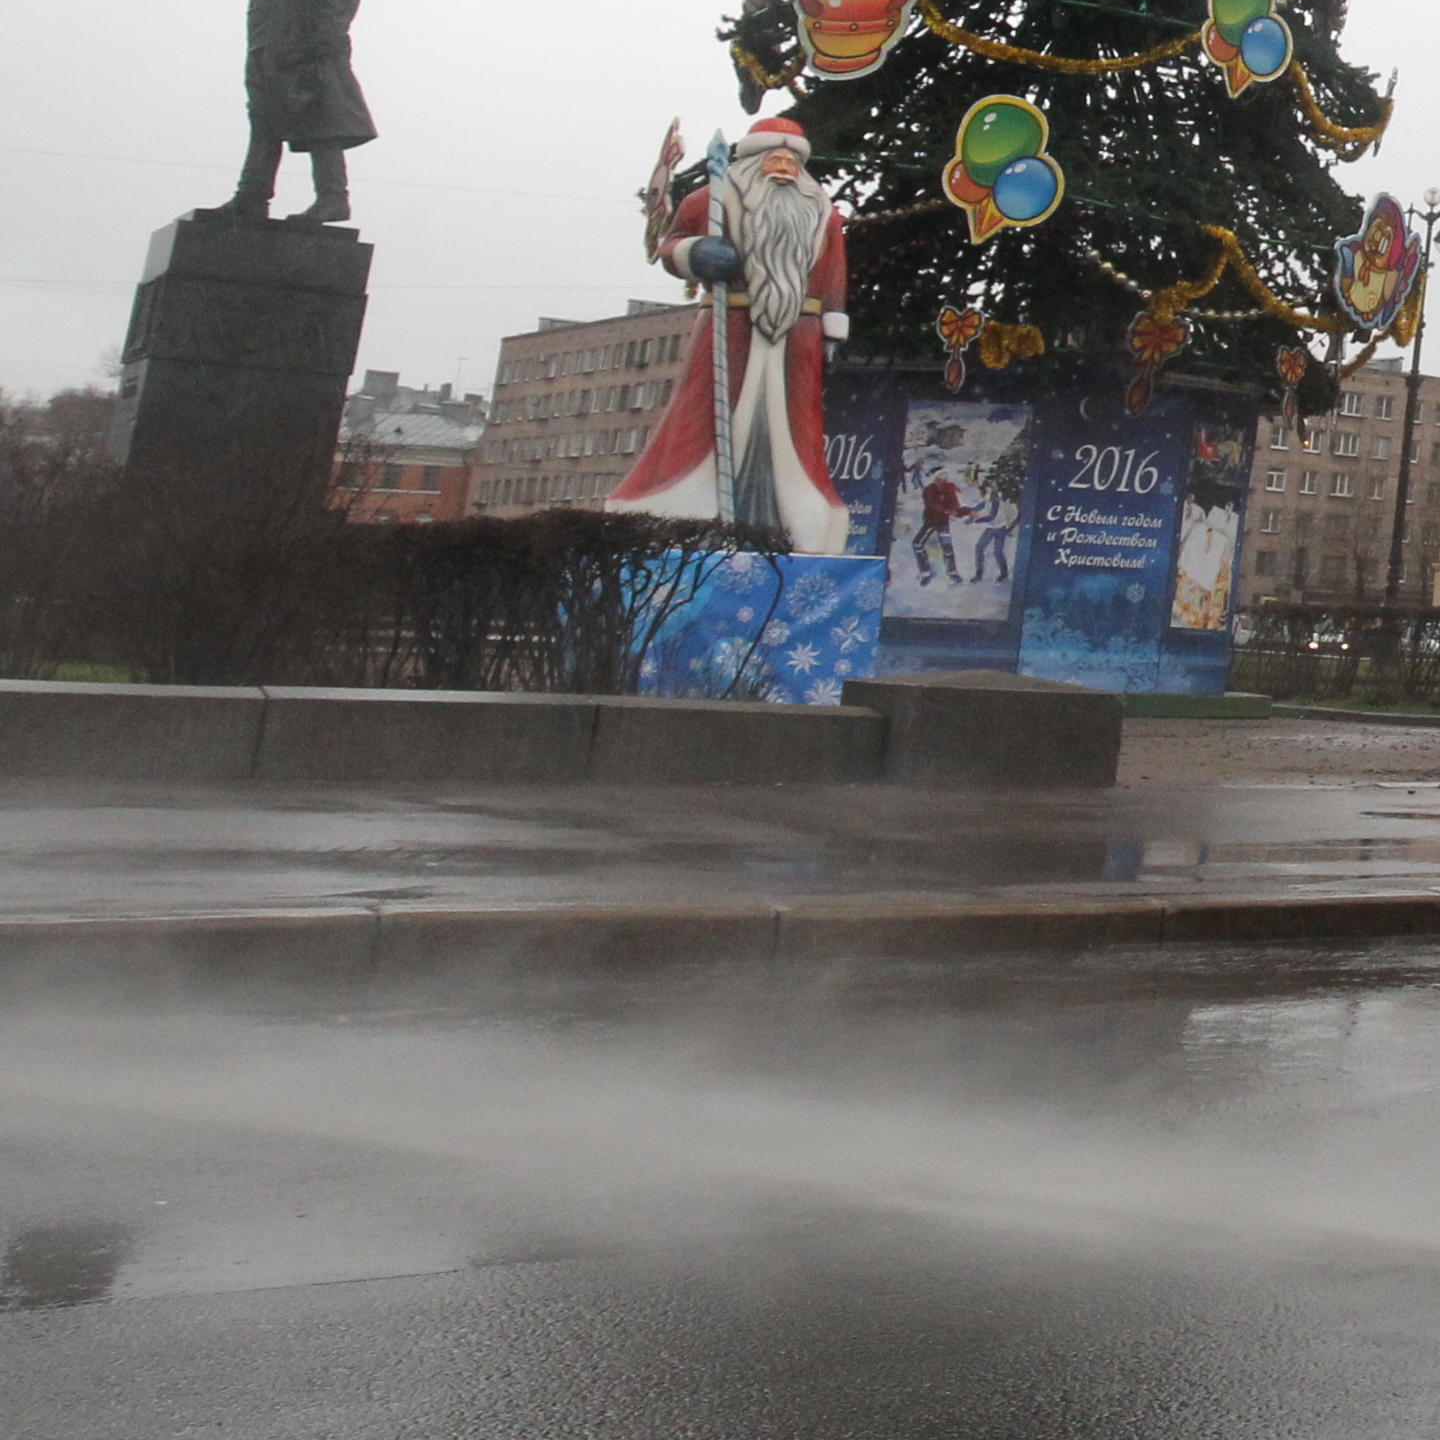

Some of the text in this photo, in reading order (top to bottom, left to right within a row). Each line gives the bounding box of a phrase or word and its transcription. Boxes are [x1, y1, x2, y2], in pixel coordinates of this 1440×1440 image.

[1068, 444, 1160, 494] 2016
[1046, 505, 1162, 528] С Новым годом
[1046, 527, 1157, 548] и Рождеством
[1054, 548, 1146, 569] Христовым!
